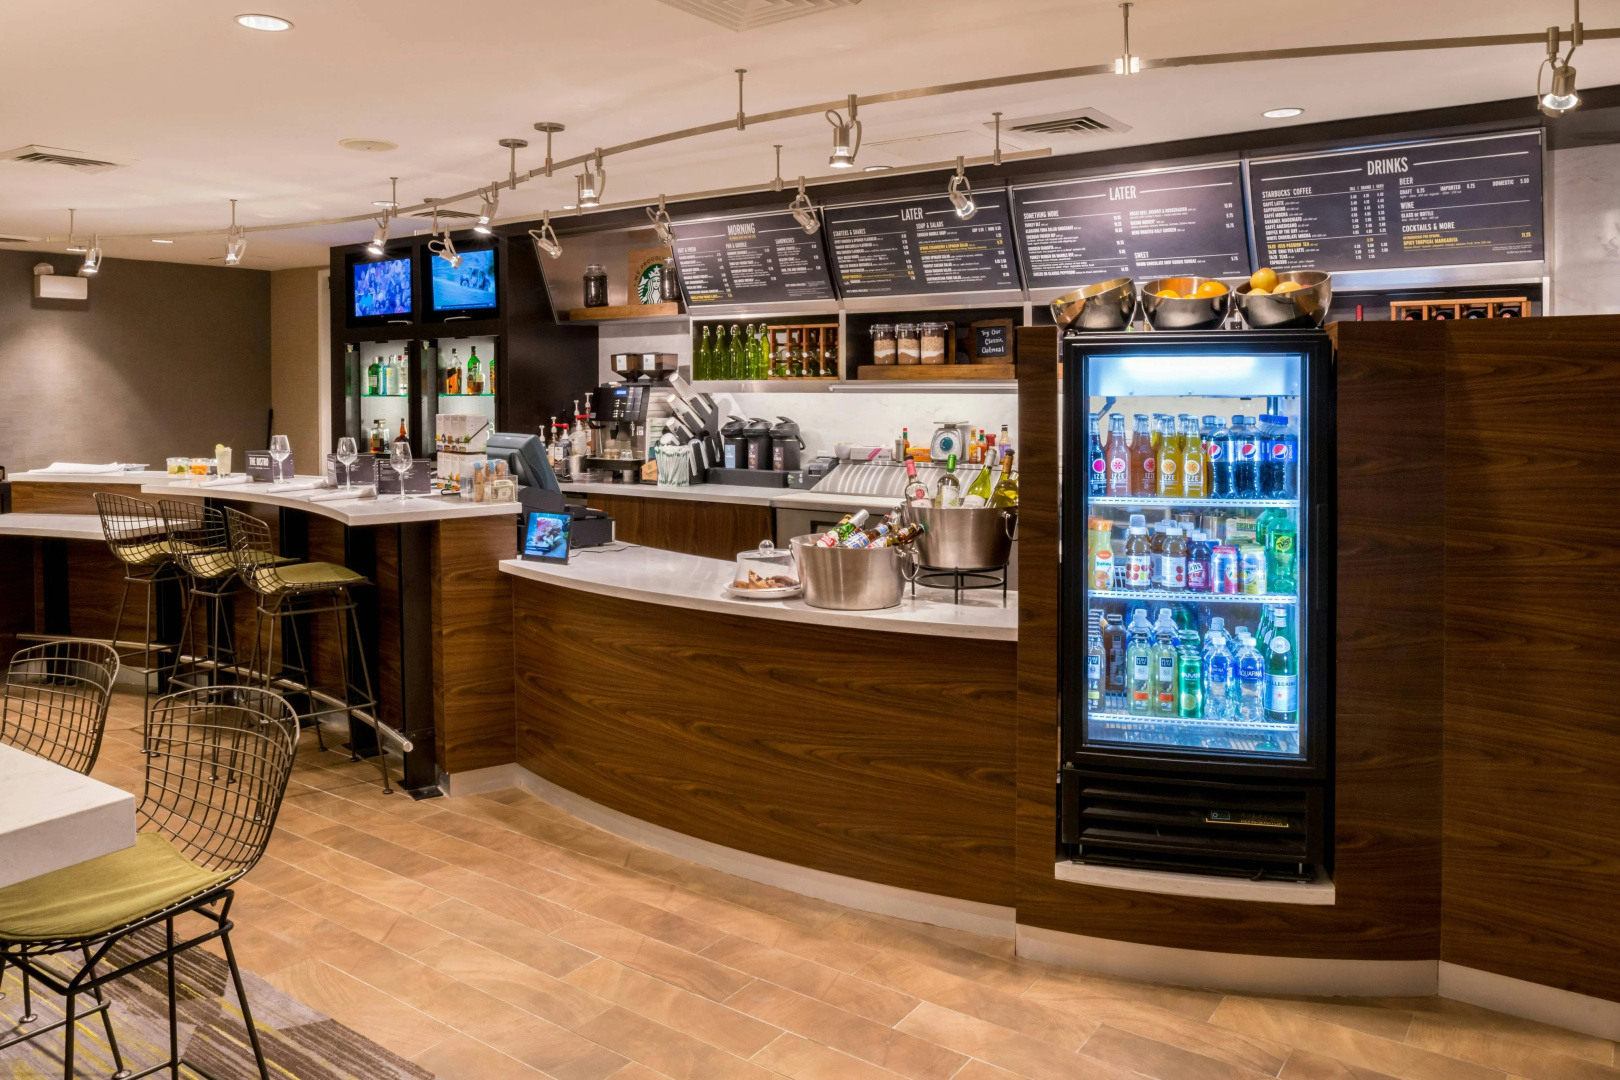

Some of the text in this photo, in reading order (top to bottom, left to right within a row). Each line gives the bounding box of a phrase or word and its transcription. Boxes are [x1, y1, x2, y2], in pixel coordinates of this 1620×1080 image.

[1367, 156, 1409, 176] DRINKS
[1399, 177, 1414, 185] BEER
[1109, 185, 1136, 200] LATER
[1262, 187, 1312, 198] STARBUCKS COFFEE
[900, 207, 924, 222] LATER
[1024, 211, 1046, 219] SOMETHING
[727, 222, 756, 236] MORNING
[1402, 222, 1432, 232] COCKTAILS
[985, 337, 1003, 345] Classic
[256, 457, 269, 466] BISTRO
